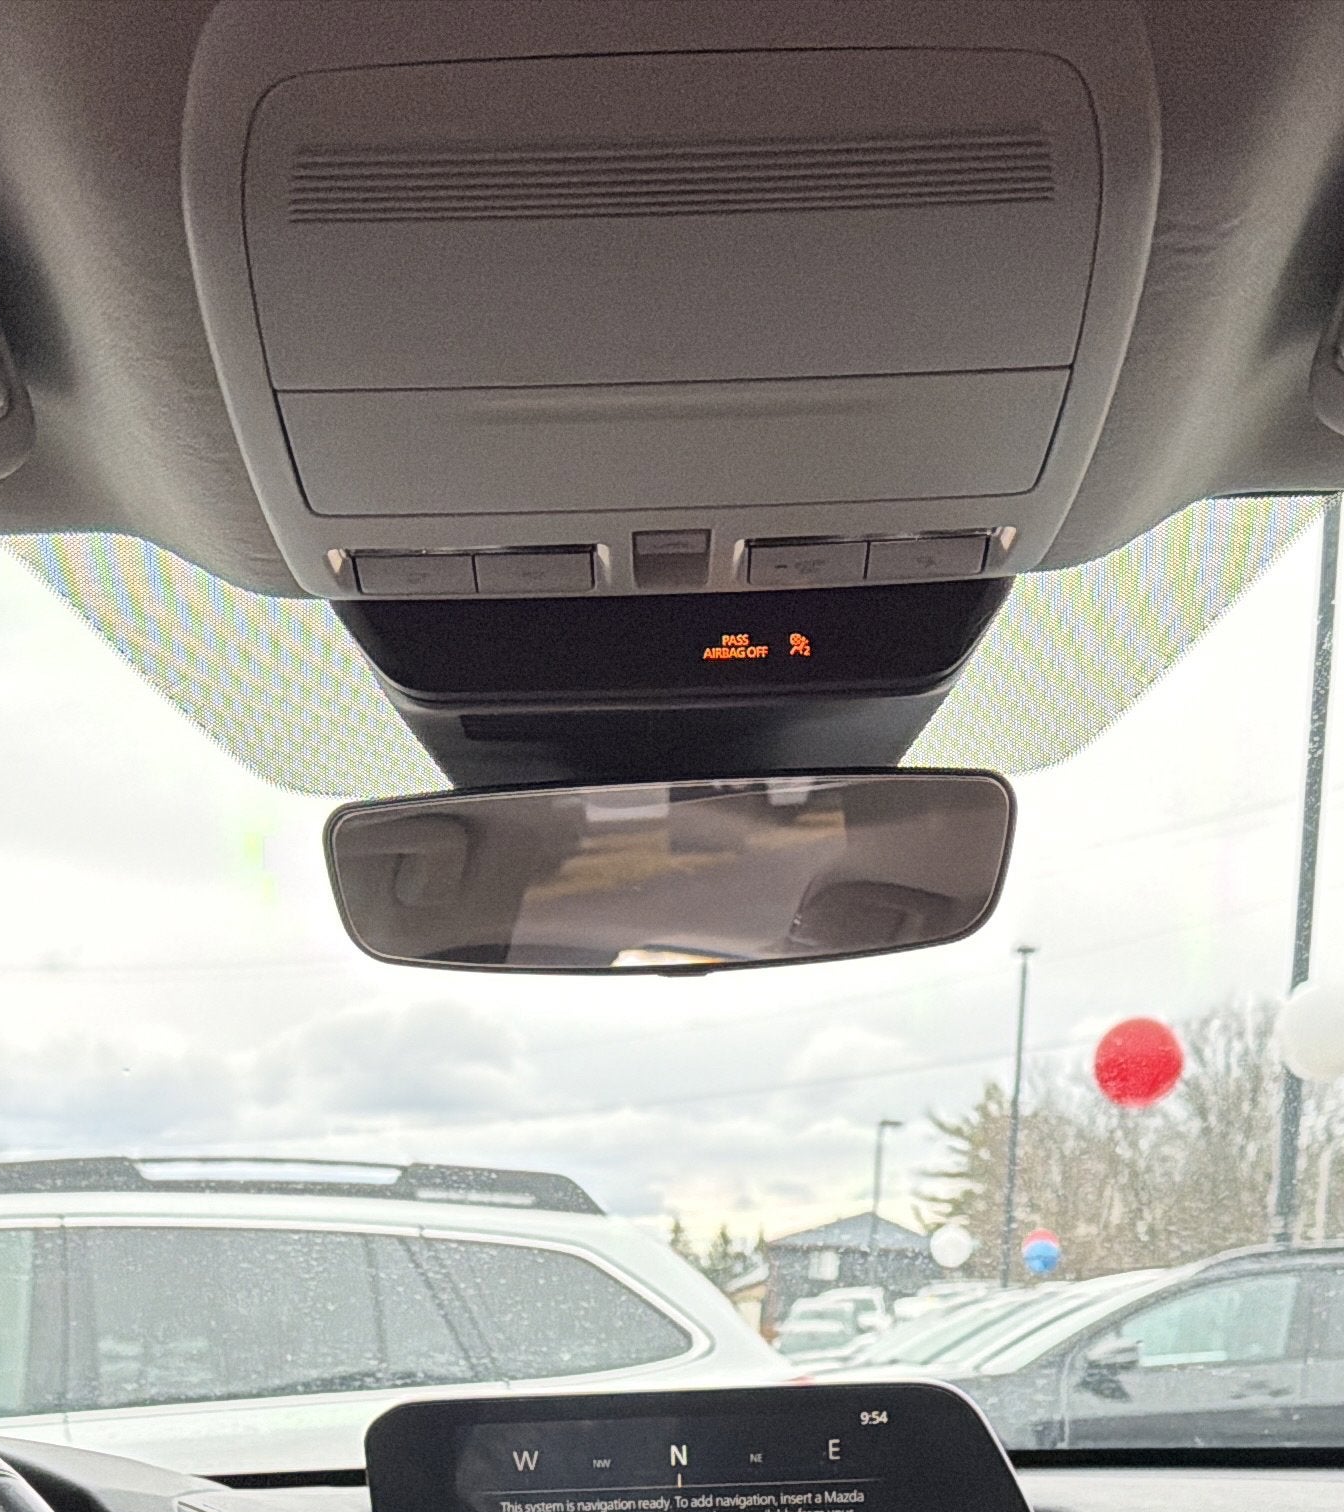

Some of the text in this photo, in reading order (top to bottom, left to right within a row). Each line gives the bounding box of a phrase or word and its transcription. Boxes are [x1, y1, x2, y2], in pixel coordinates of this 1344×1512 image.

[721, 633, 750, 646] PASS
[702, 647, 746, 659] AIRBAG
[746, 646, 769, 658] OFF
[860, 1411, 888, 1425] 9:54
[512, 1439, 840, 1471] W NW N NE E
[501, 1501, 523, 1512] This
[566, 1499, 576, 1512] is
[637, 1496, 673, 1512] ready.
[674, 1496, 689, 1509] To
[691, 1494, 713, 1508] add
[715, 1493, 778, 1509] navigation,
[780, 1492, 812, 1505] insert
[814, 1494, 822, 1504] a
[824, 1490, 865, 1504] Mazda
